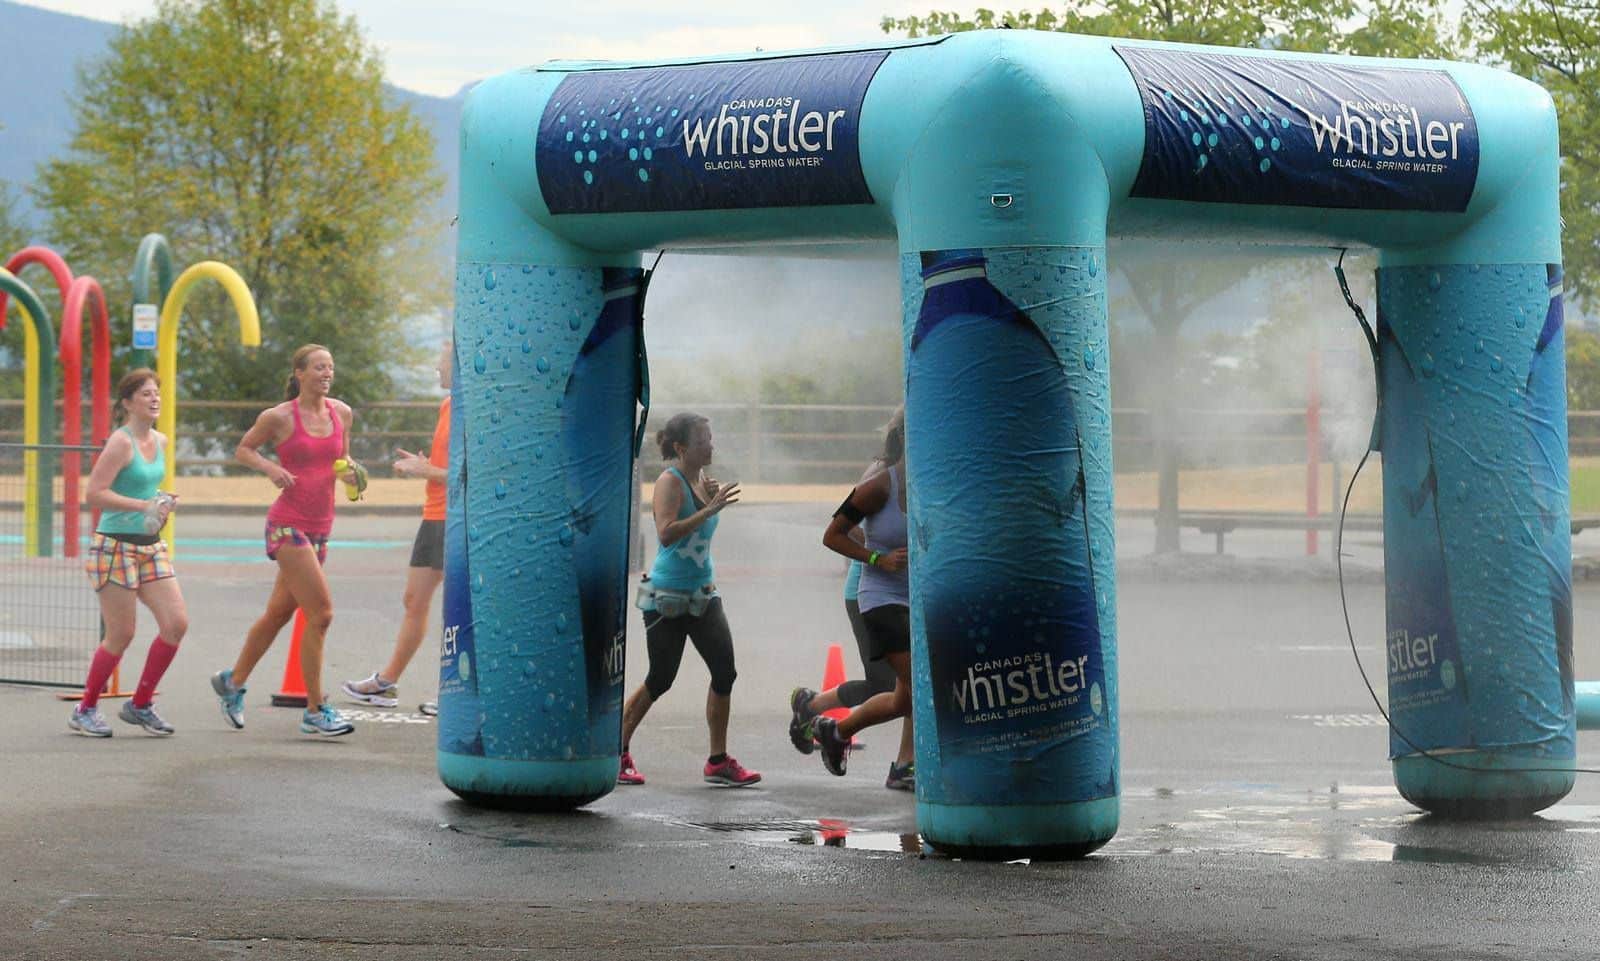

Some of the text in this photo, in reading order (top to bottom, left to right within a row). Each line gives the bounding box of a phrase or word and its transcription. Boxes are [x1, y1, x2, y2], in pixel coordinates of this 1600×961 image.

[730, 96, 793, 110] CANADA'S
[683, 99, 846, 158] whistler
[1308, 100, 1464, 160] whistler
[704, 160, 746, 170] GLACIAL
[748, 158, 784, 169] SPRING
[1332, 158, 1373, 169] GLACIAL
[1376, 161, 1410, 172] SPRING
[974, 652, 1042, 672] CANADA'S
[951, 653, 1089, 712] whistler
[964, 711, 1004, 724] GLACIAL
[1007, 703, 1047, 718] SPRING
